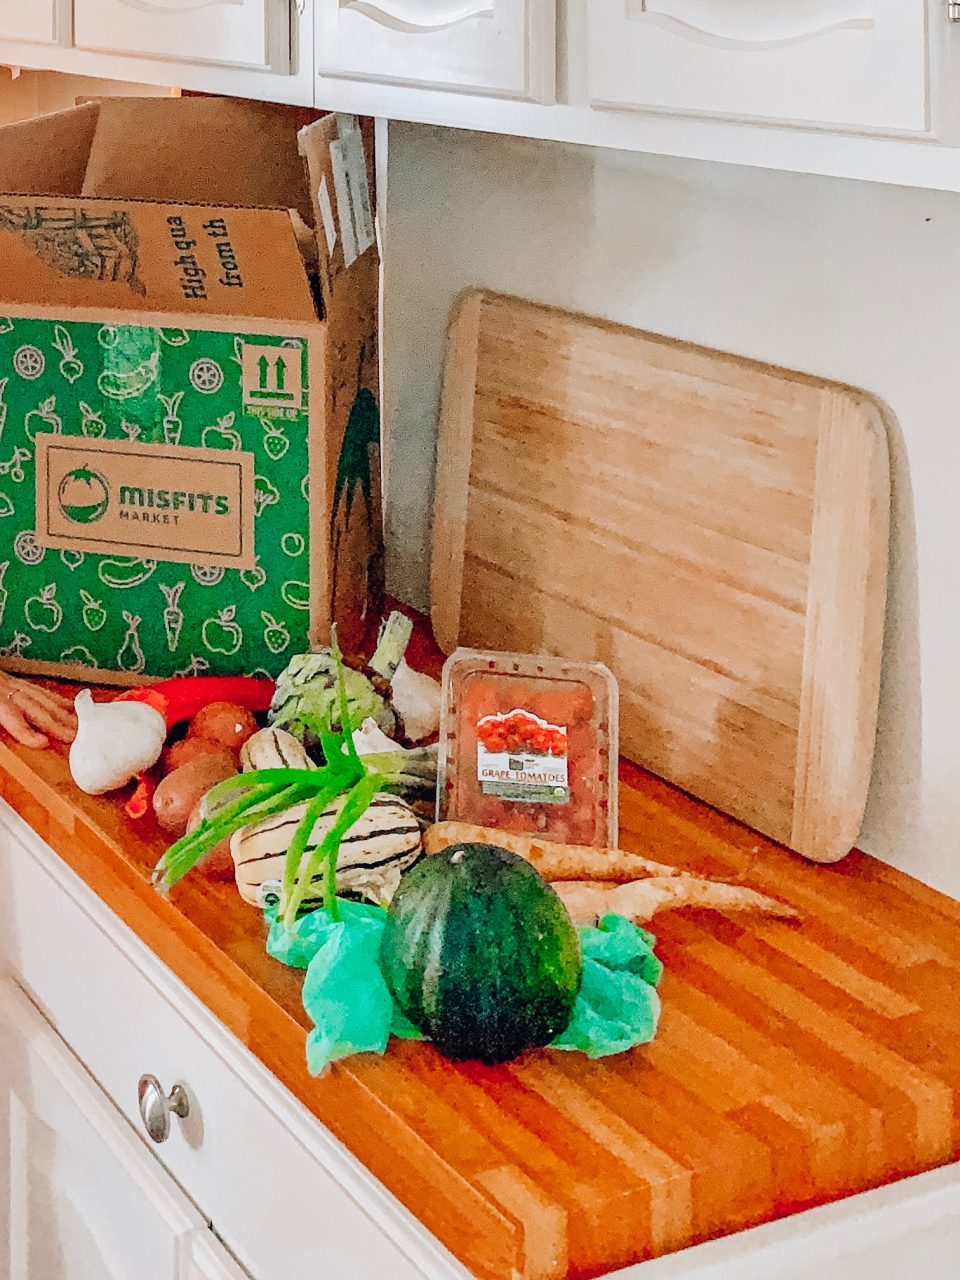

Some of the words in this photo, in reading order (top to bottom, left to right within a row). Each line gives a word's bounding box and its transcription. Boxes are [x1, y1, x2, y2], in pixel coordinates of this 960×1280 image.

[173, 255, 207, 300] High
[216, 242, 243, 287] from
[119, 485, 230, 515] MISFITS
[119, 510, 179, 525] MARKET
[481, 768, 511, 779] GRAPE
[515, 771, 566, 782] TOMATOES
